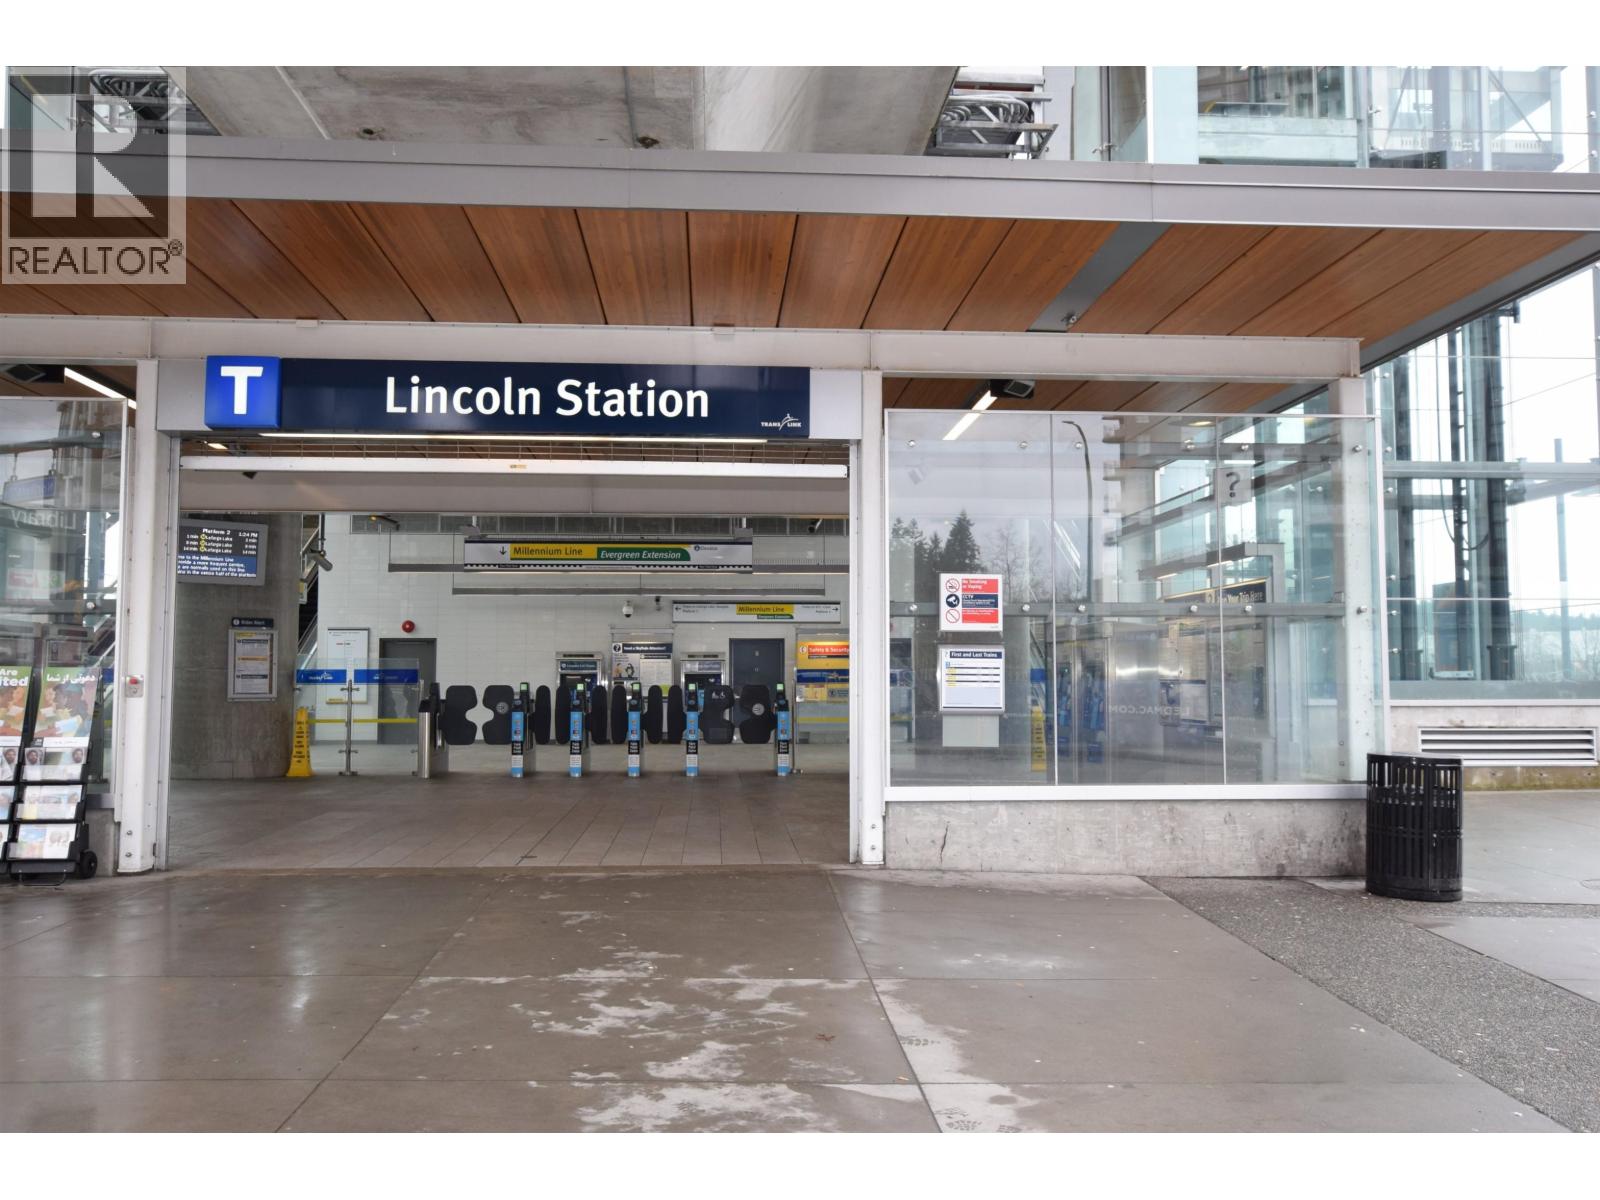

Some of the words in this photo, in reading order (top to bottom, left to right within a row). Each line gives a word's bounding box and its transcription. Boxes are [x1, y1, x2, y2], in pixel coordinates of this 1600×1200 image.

[220, 365, 264, 415] T
[386, 375, 541, 416] Lincoln
[556, 378, 709, 418] Station
[513, 546, 562, 556] Millennium
[565, 546, 583, 556] Line
[600, 550, 641, 561] Evergreen
[642, 550, 682, 560] Extension
[772, 606, 785, 614] Line
